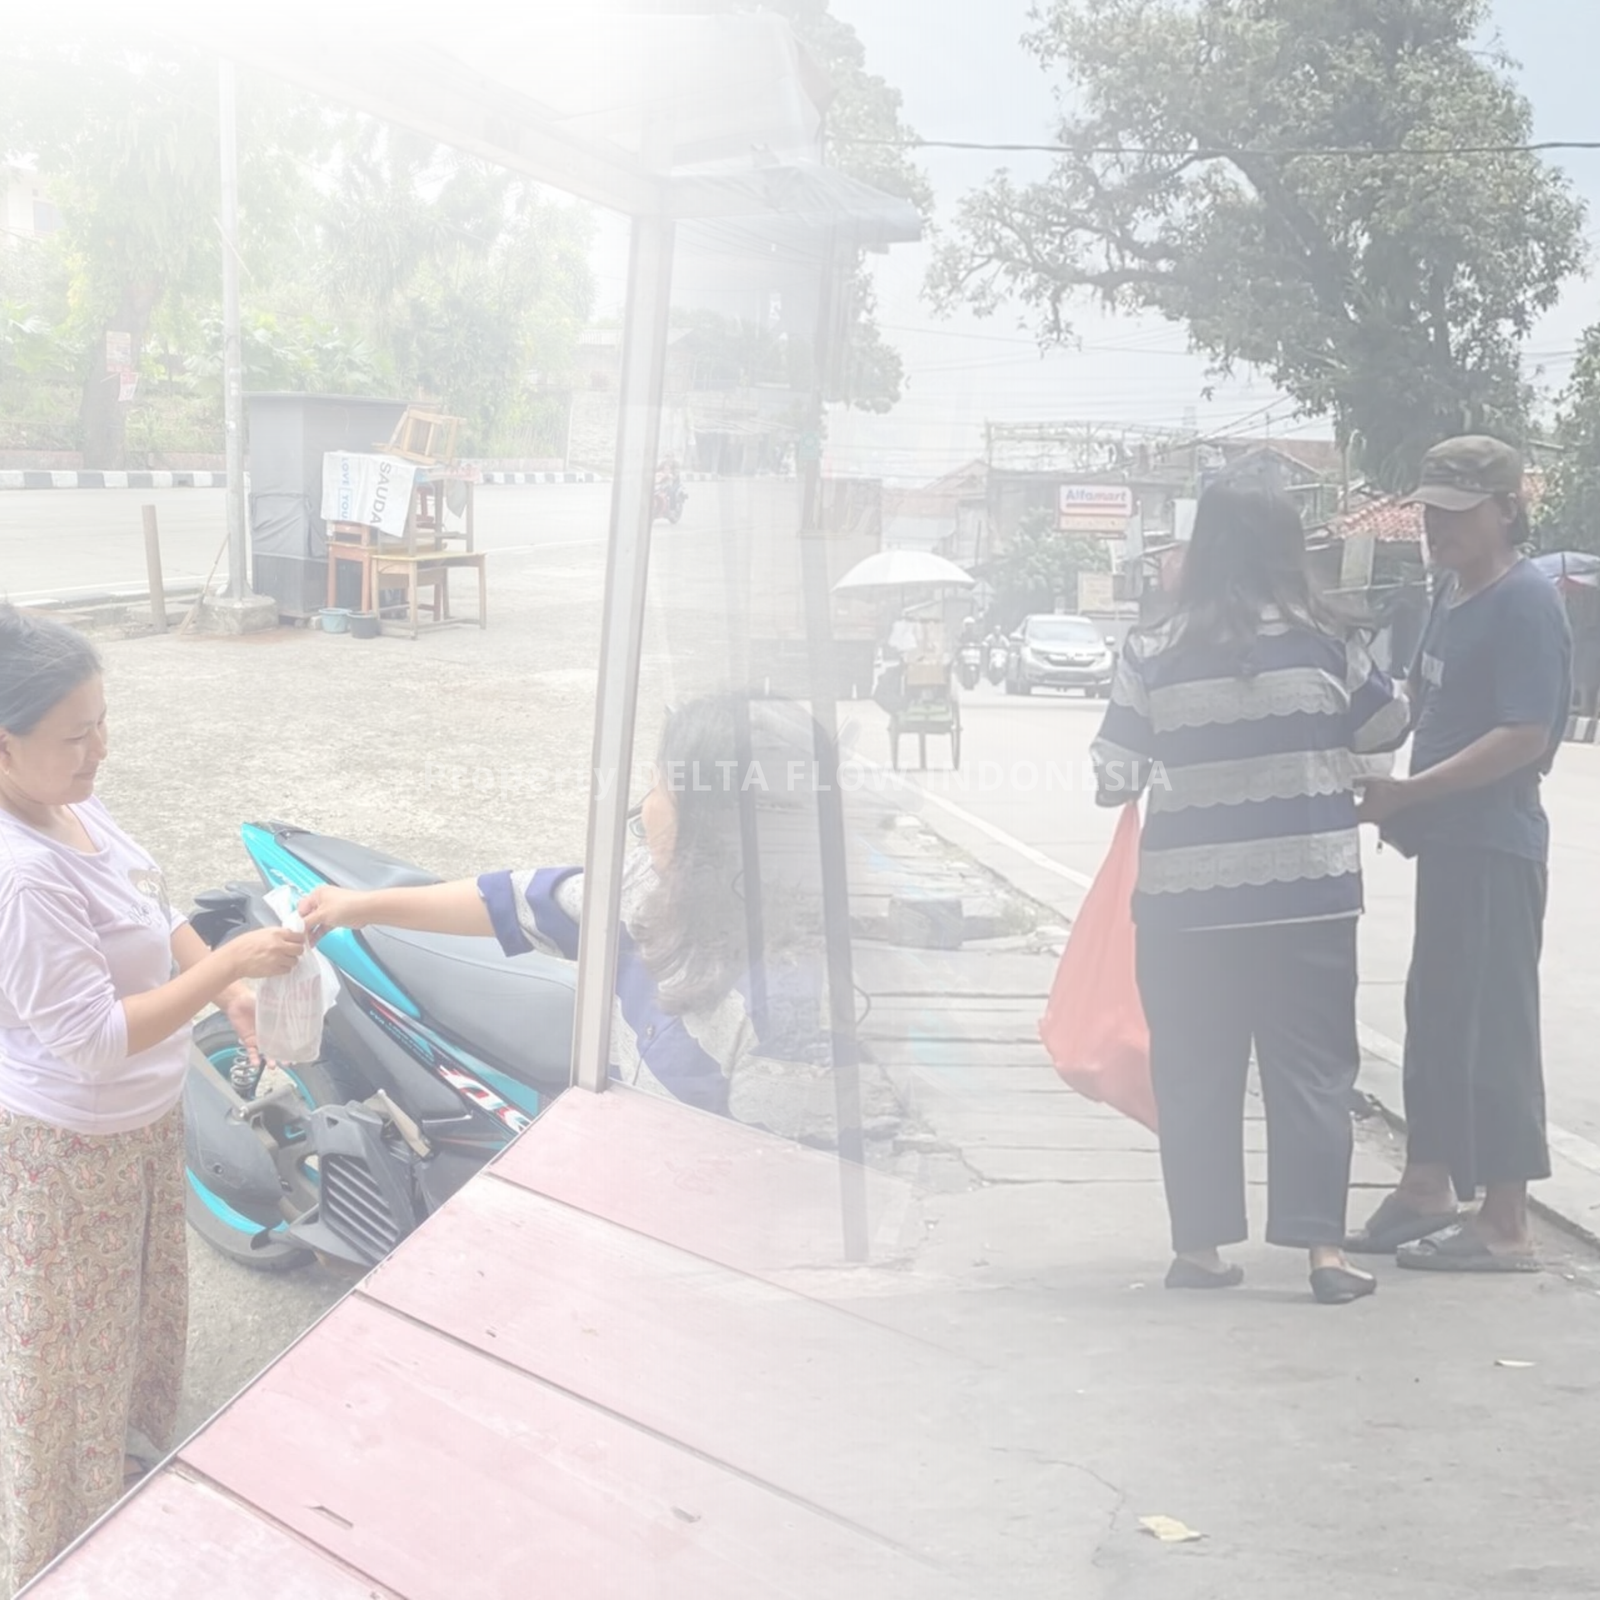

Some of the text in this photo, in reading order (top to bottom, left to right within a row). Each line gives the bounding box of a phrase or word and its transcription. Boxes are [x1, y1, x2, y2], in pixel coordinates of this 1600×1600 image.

[341, 456, 350, 519] LOVE YOU
[370, 461, 392, 524] SAUDA
[1066, 489, 1127, 501] Alfamart
